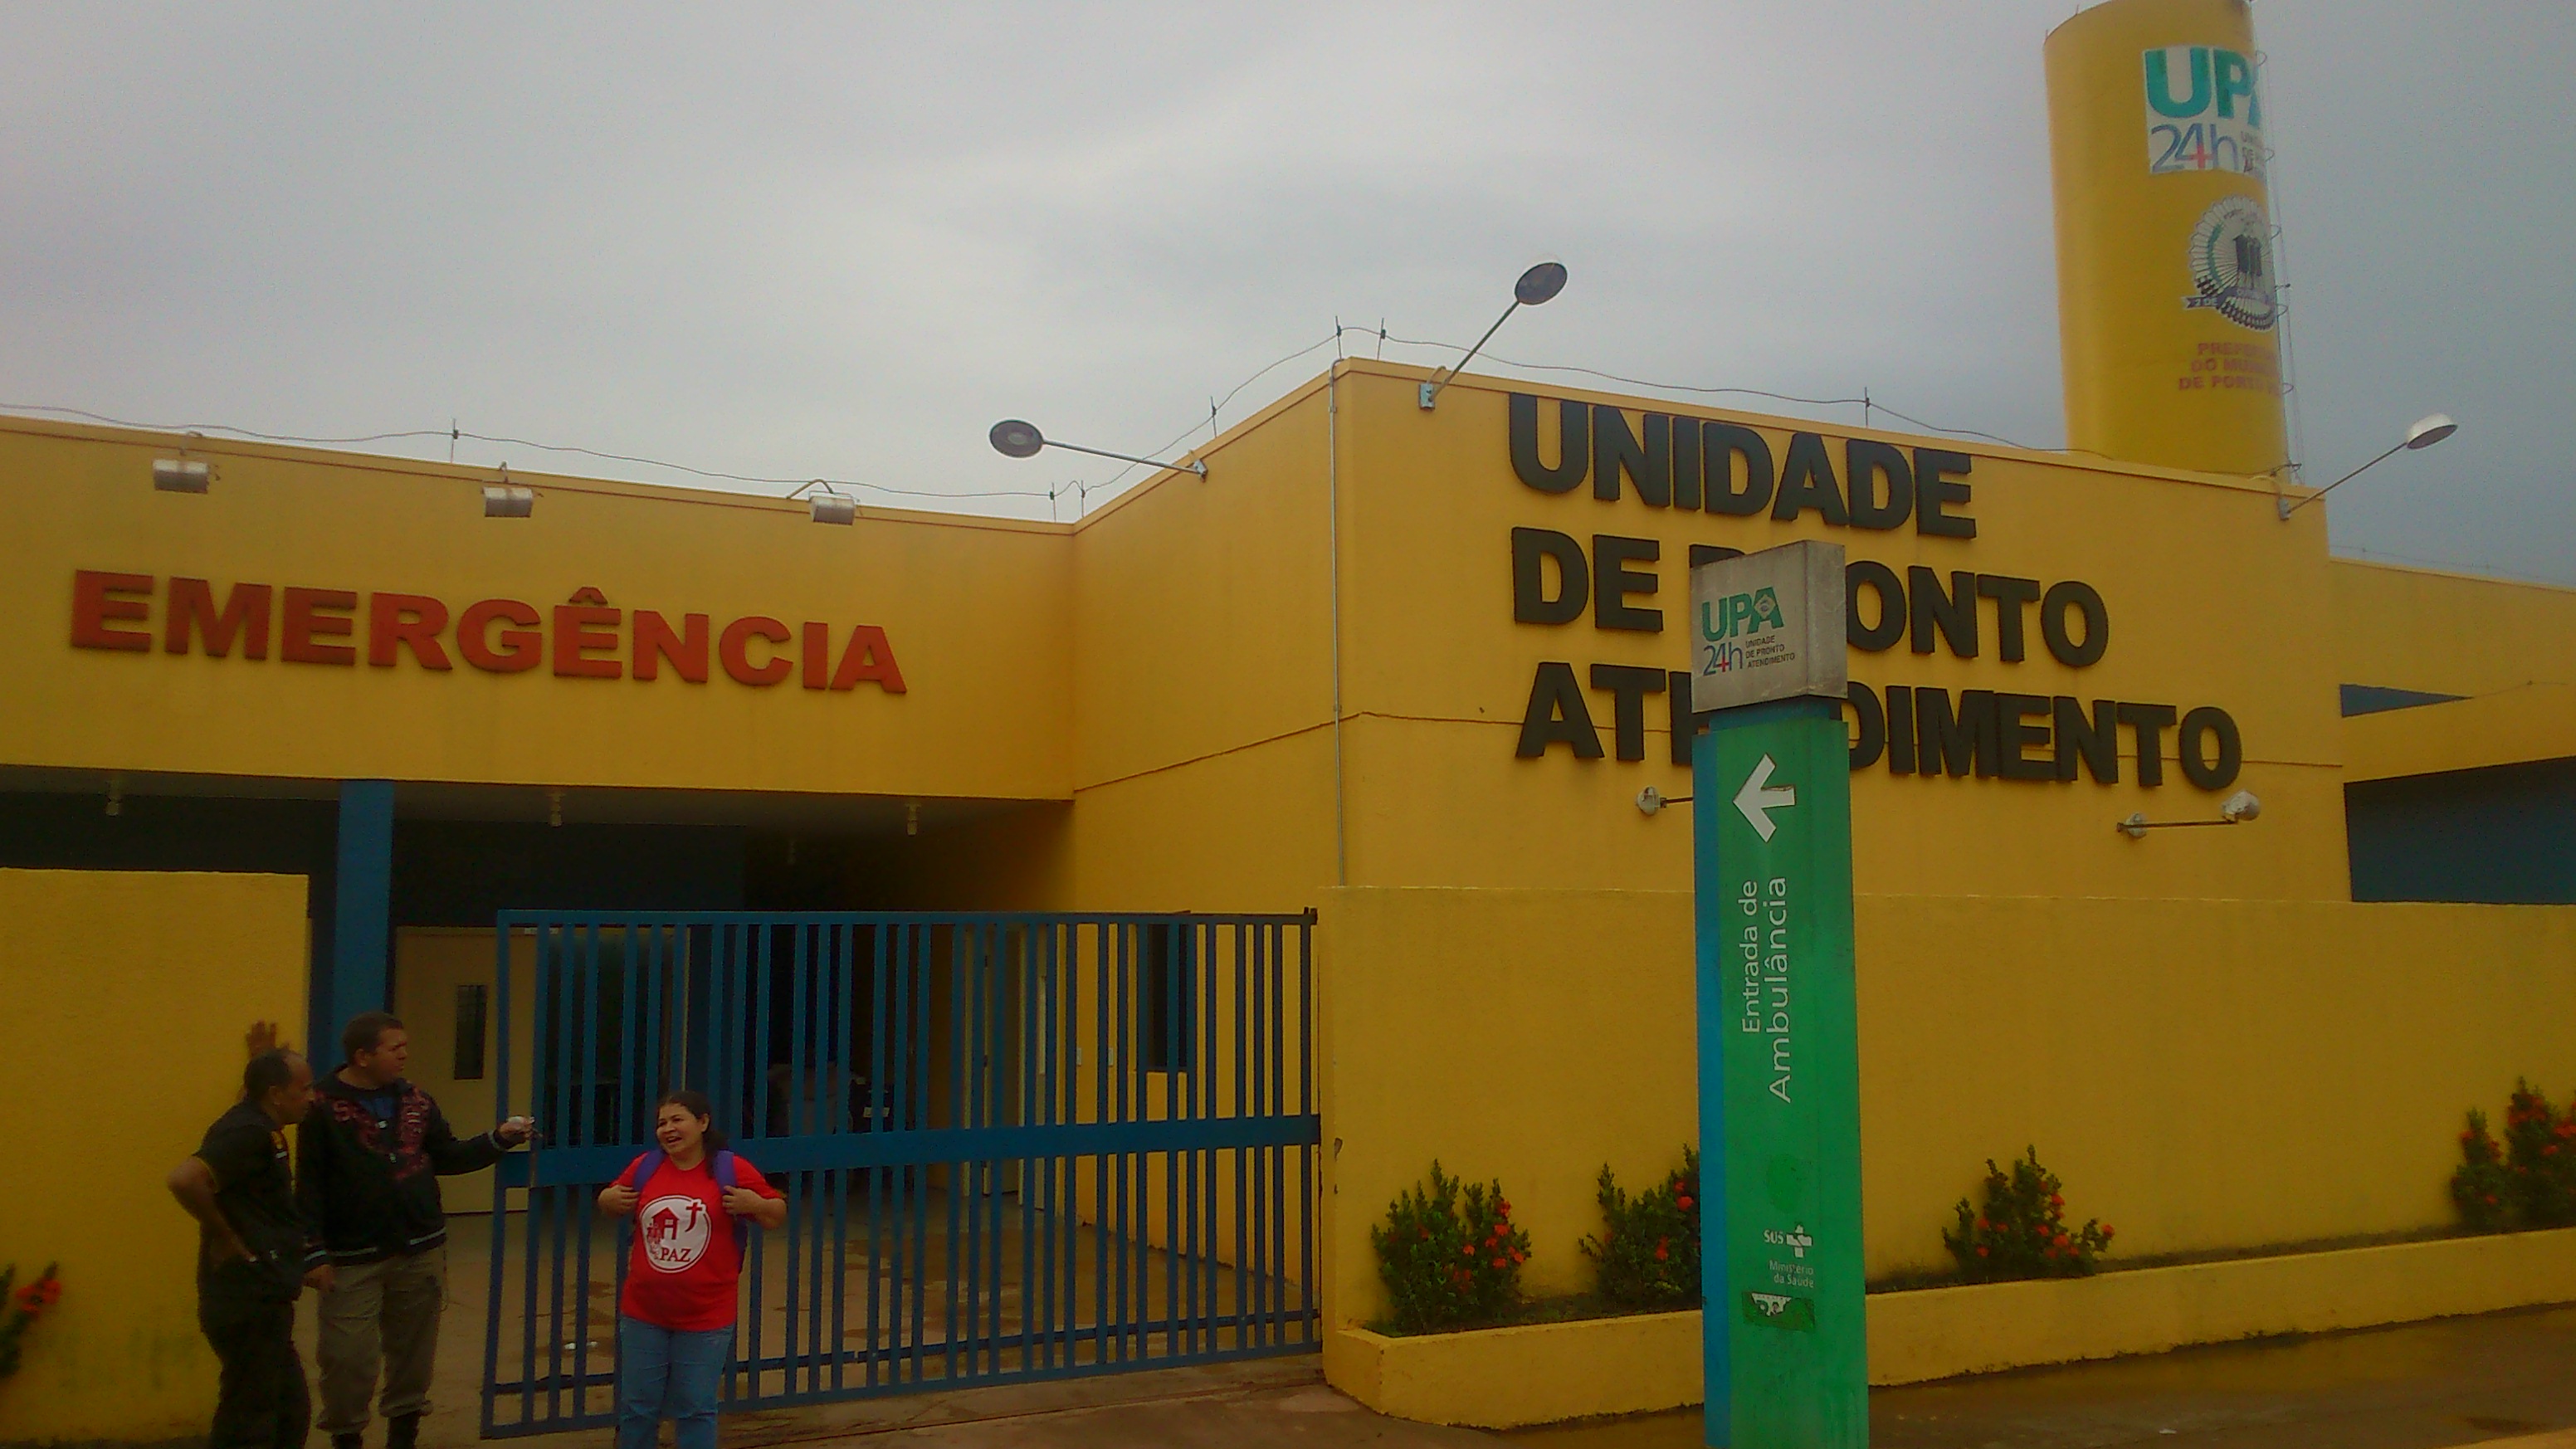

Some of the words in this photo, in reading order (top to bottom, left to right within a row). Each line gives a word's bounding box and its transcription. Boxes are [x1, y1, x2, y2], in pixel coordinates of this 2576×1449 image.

[2151, 123, 2240, 173] 24h
[1509, 393, 1977, 539] UNIDADE
[1510, 527, 1663, 632] DE
[1690, 544, 2109, 667] ONTO
[1702, 586, 1784, 642] UPA
[70, 568, 908, 694] EMERGÊNCIA
[1745, 635, 1776, 648] UNIDADE
[1745, 650, 1755, 659] DE
[1756, 643, 1785, 657] PRONTO
[1703, 642, 1743, 676] 24h
[1747, 652, 1796, 669] ATENDIMENTO
[1515, 662, 2242, 791] ATDIMENTO
[1738, 879, 1758, 916] de
[1739, 925, 1760, 1034] Entrada
[1763, 876, 1792, 1104] Ambulância
[660, 1247, 692, 1263] PAZ
[1764, 1228, 1784, 1244] SUS
[1773, 1272, 1785, 1284] da
